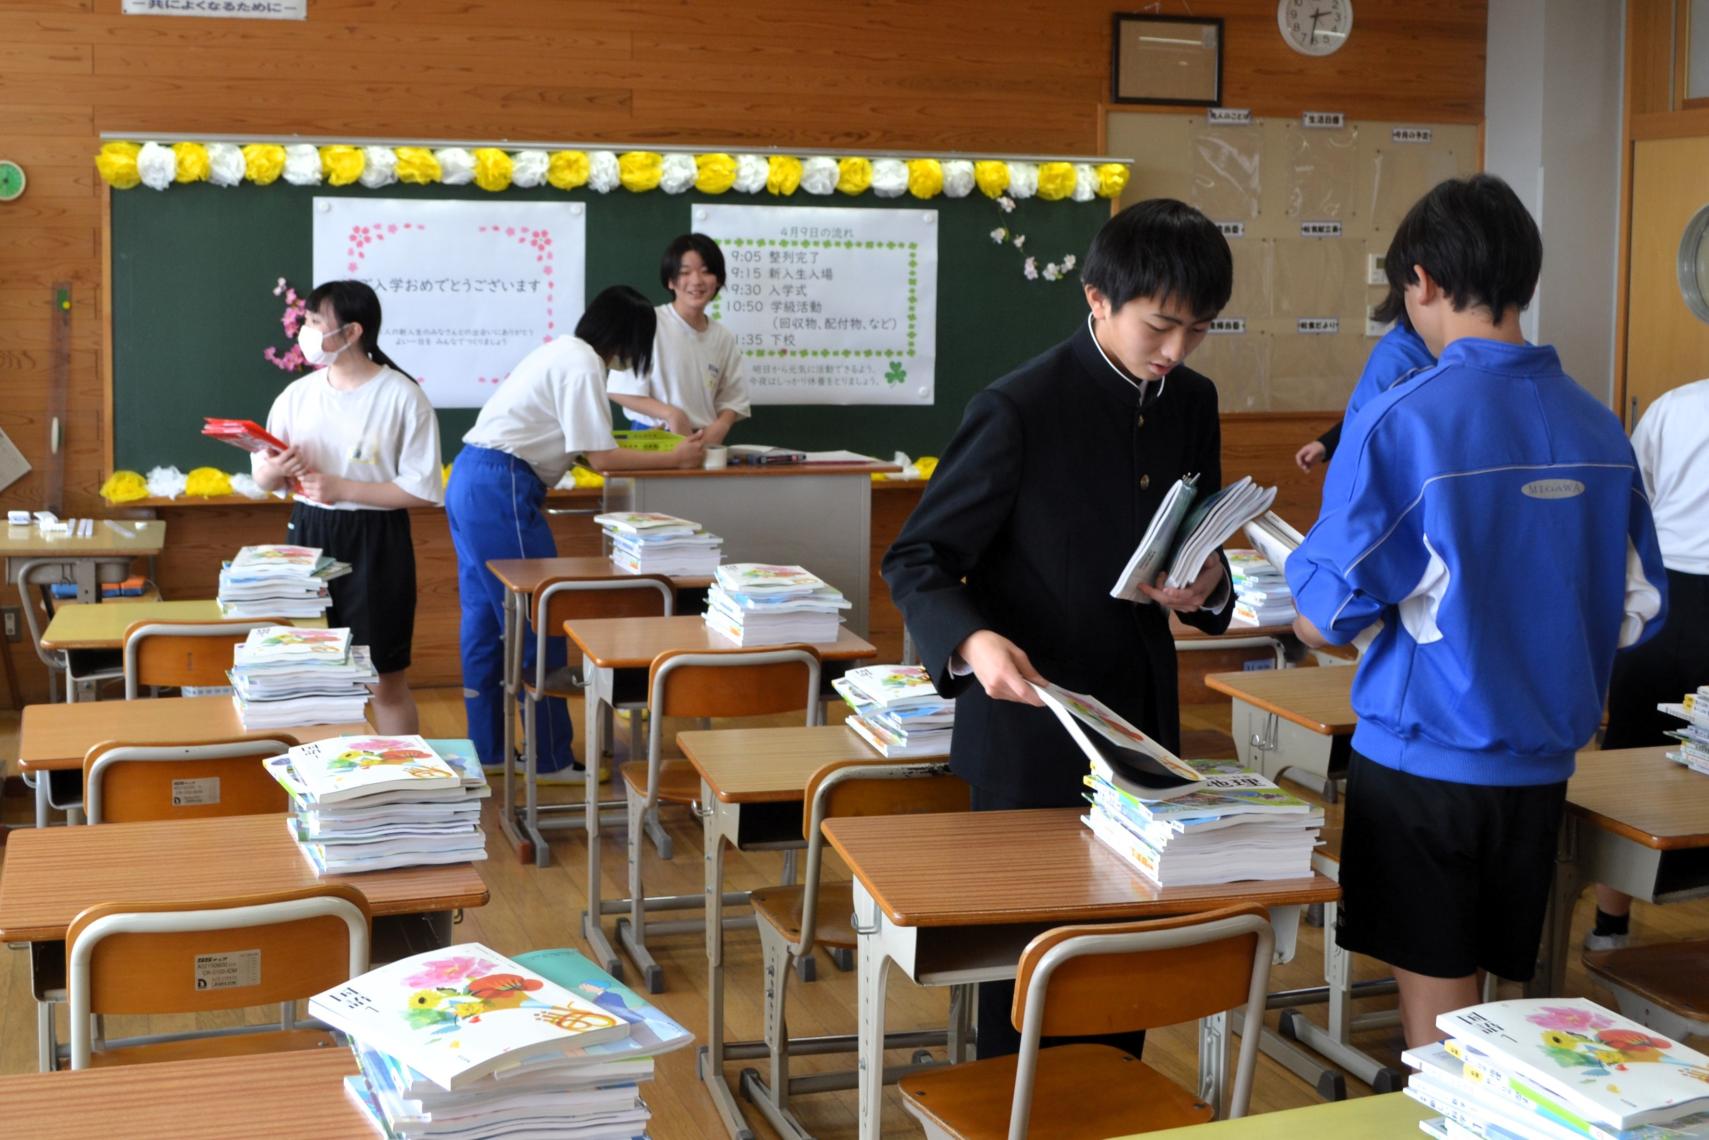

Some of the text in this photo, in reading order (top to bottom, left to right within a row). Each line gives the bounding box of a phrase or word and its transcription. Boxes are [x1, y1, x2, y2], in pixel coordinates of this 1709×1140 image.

[780, 226, 854, 239] 4月9日の流れ
[731, 250, 819, 264] 9:05 整列完了
[731, 267, 833, 280] 9:15 新入生入場
[731, 283, 808, 297] 9:30 入学式
[727, 300, 822, 313] 10:50 学級活動
[735, 333, 796, 347] 1:35 下校
